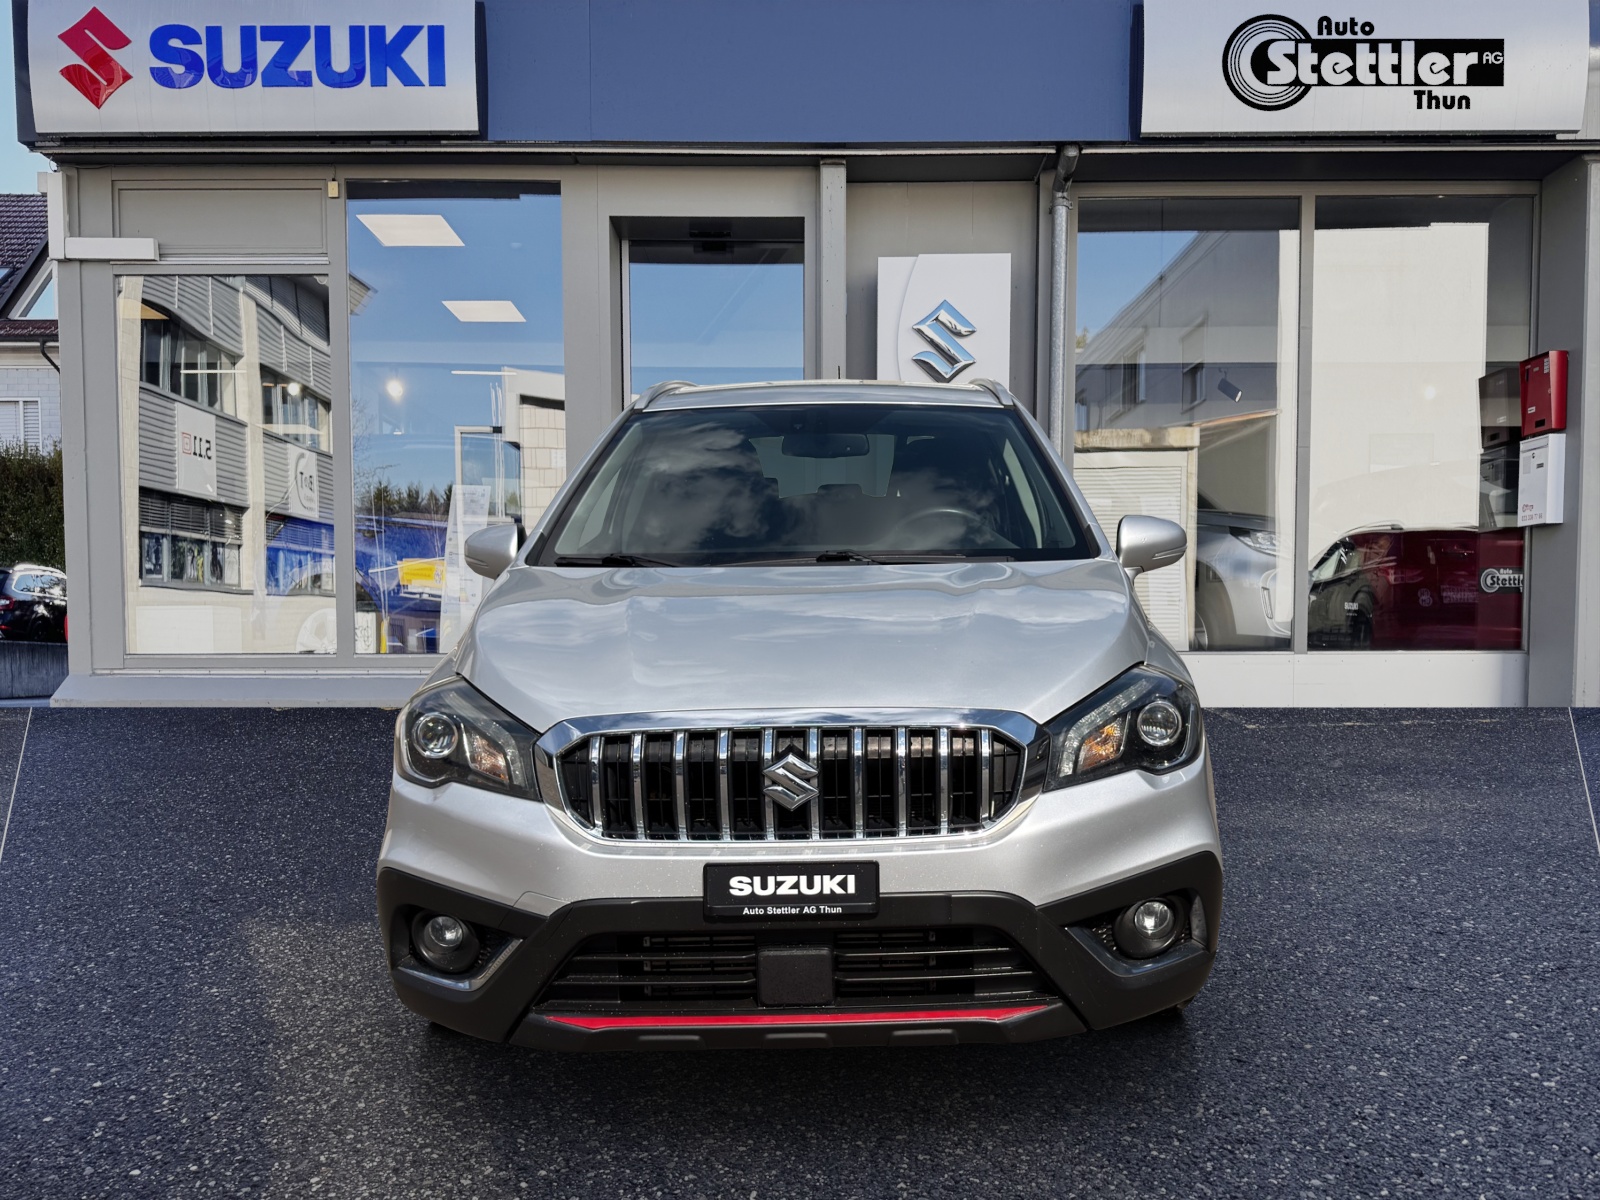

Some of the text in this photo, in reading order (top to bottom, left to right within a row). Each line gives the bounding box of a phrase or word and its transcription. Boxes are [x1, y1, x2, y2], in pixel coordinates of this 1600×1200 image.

[1317, 15, 1375, 36] Auto
[149, 24, 446, 89] SUZUKI
[1267, 40, 1504, 86] Stettler AG
[1413, 90, 1471, 110] Thun
[728, 875, 856, 897] SUZUKI
[743, 905, 843, 915] Auto Stettler AG Thun
